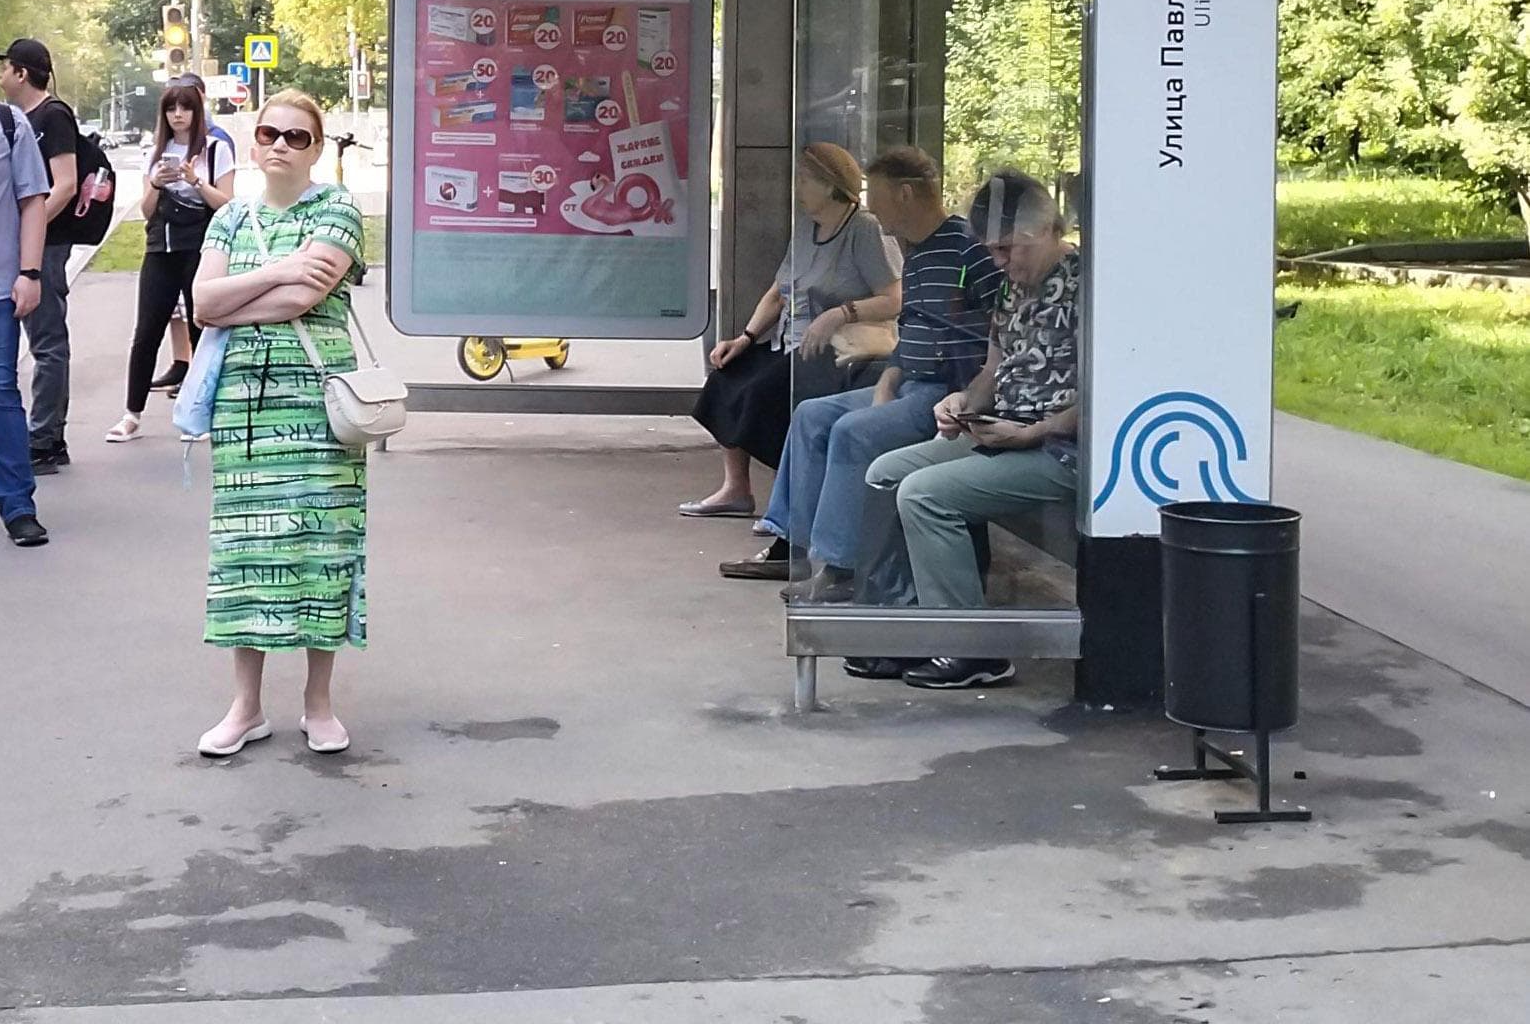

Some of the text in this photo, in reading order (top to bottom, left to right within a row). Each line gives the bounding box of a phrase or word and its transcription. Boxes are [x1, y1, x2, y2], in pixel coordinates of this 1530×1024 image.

[472, 14, 494, 28] 20
[537, 29, 559, 43] 20
[605, 31, 627, 45] 20
[653, 57, 675, 71] 20
[597, 106, 619, 119] 20
[1159, 78, 1187, 168] Улица
[288, 511, 328, 532] SKY
